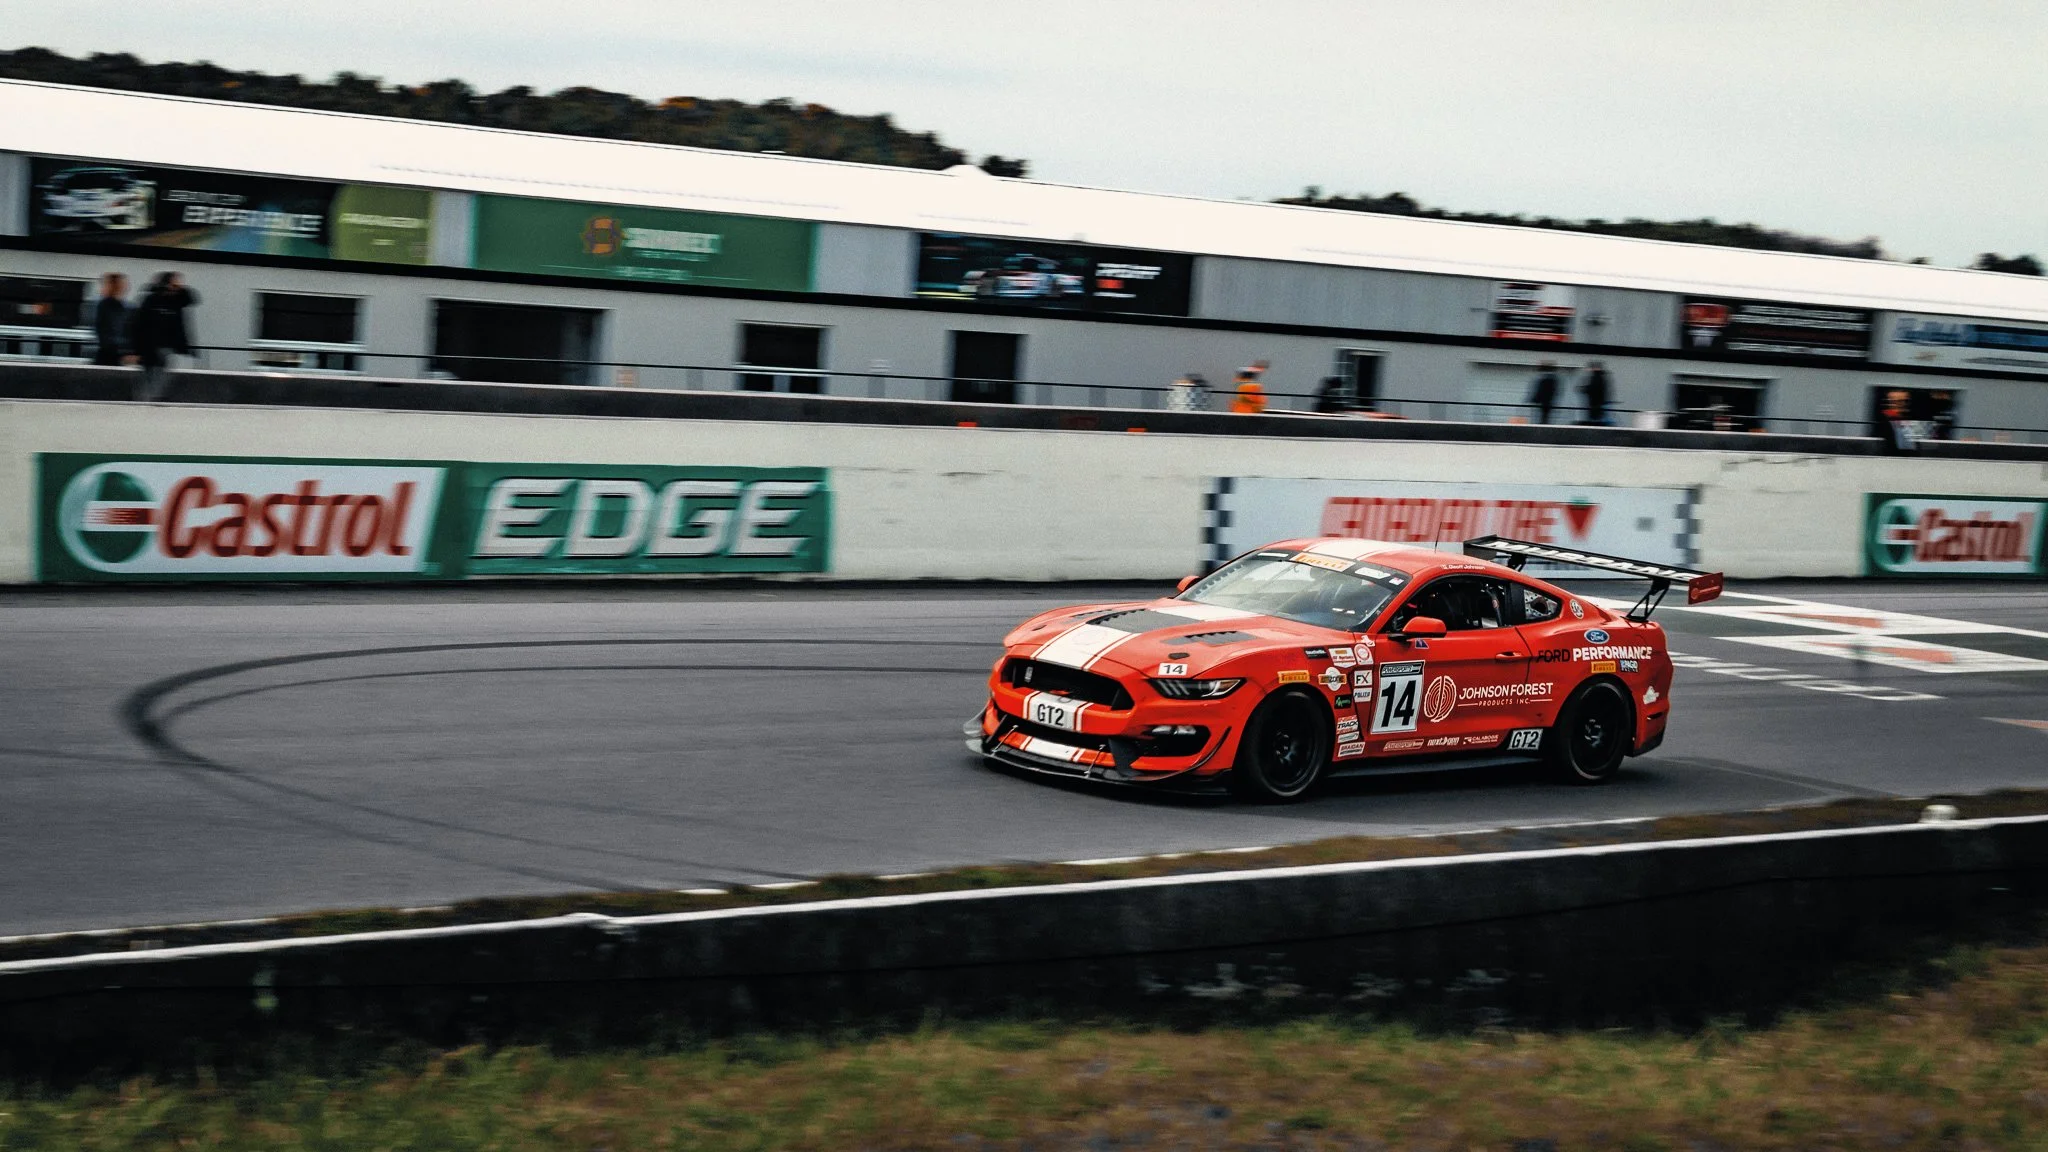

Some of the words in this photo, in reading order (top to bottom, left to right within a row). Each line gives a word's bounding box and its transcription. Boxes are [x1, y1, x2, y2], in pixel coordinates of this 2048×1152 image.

[158, 475, 417, 559] Castrol
[469, 476, 822, 559] EDGE
[1589, 631, 1605, 641] Ford
[1536, 648, 1571, 662] FORD
[1572, 645, 1653, 661] PERFORMANCE
[1162, 664, 1183, 675] 14
[1355, 671, 1370, 684] FX
[1459, 684, 1510, 700] JOHNSON
[1510, 682, 1553, 697] FOREST
[1380, 680, 1417, 728] 14
[1478, 699, 1513, 707] PRODUCTS
[1516, 697, 1531, 705] INC.
[1037, 702, 1064, 727] GT2
[1511, 731, 1540, 749] GT2
